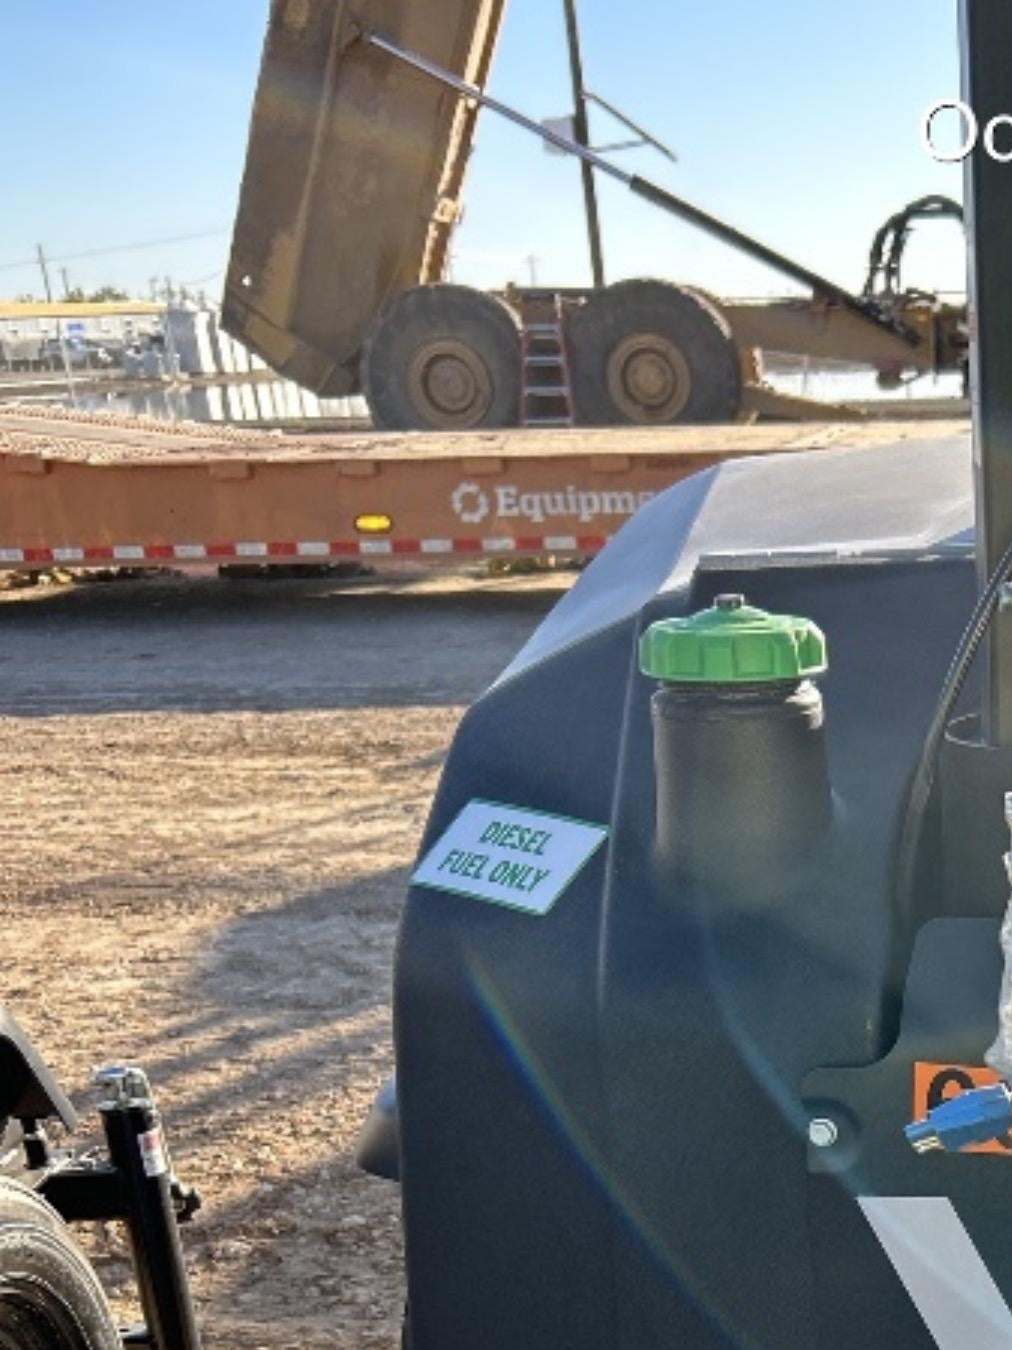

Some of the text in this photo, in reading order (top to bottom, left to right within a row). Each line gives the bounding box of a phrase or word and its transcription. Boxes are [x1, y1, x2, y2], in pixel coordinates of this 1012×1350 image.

[477, 821, 552, 856] DIESEL
[437, 848, 550, 893] FUEL ONLY
